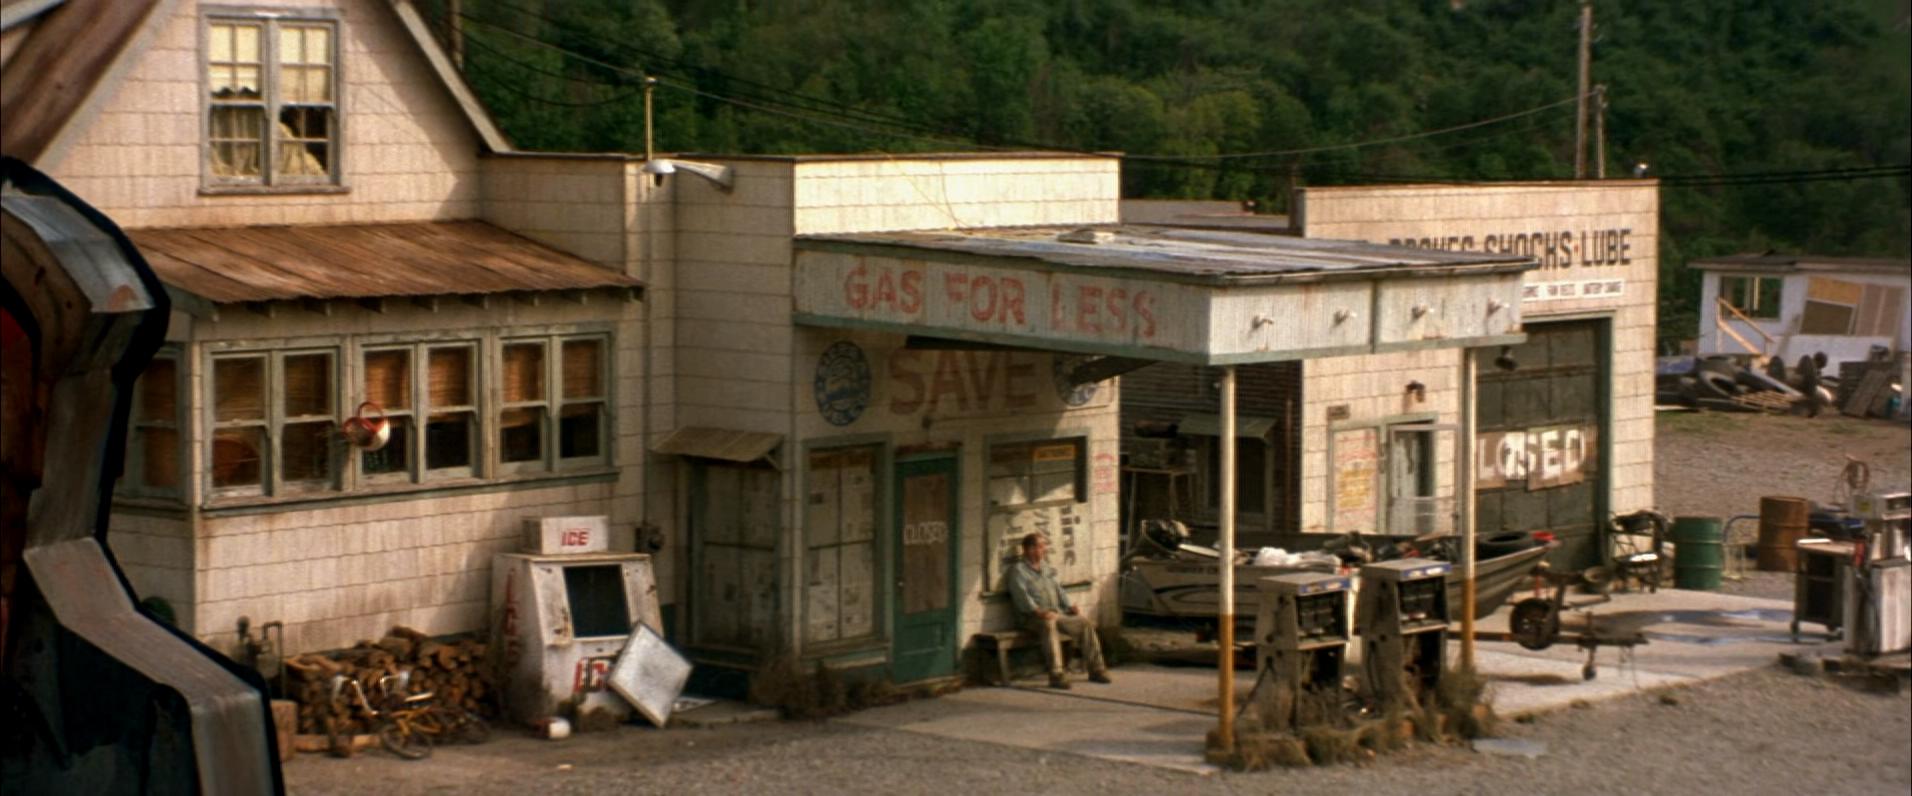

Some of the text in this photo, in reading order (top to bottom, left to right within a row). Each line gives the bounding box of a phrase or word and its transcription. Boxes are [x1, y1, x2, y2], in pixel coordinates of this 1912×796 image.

[1581, 228, 1631, 266] LUBE
[843, 264, 1156, 338] GAS FOR LESS
[889, 350, 1037, 415] SAVE
[1479, 429, 1585, 480] LOSED
[561, 530, 590, 547] ICE
[903, 520, 948, 545] CLOSED
